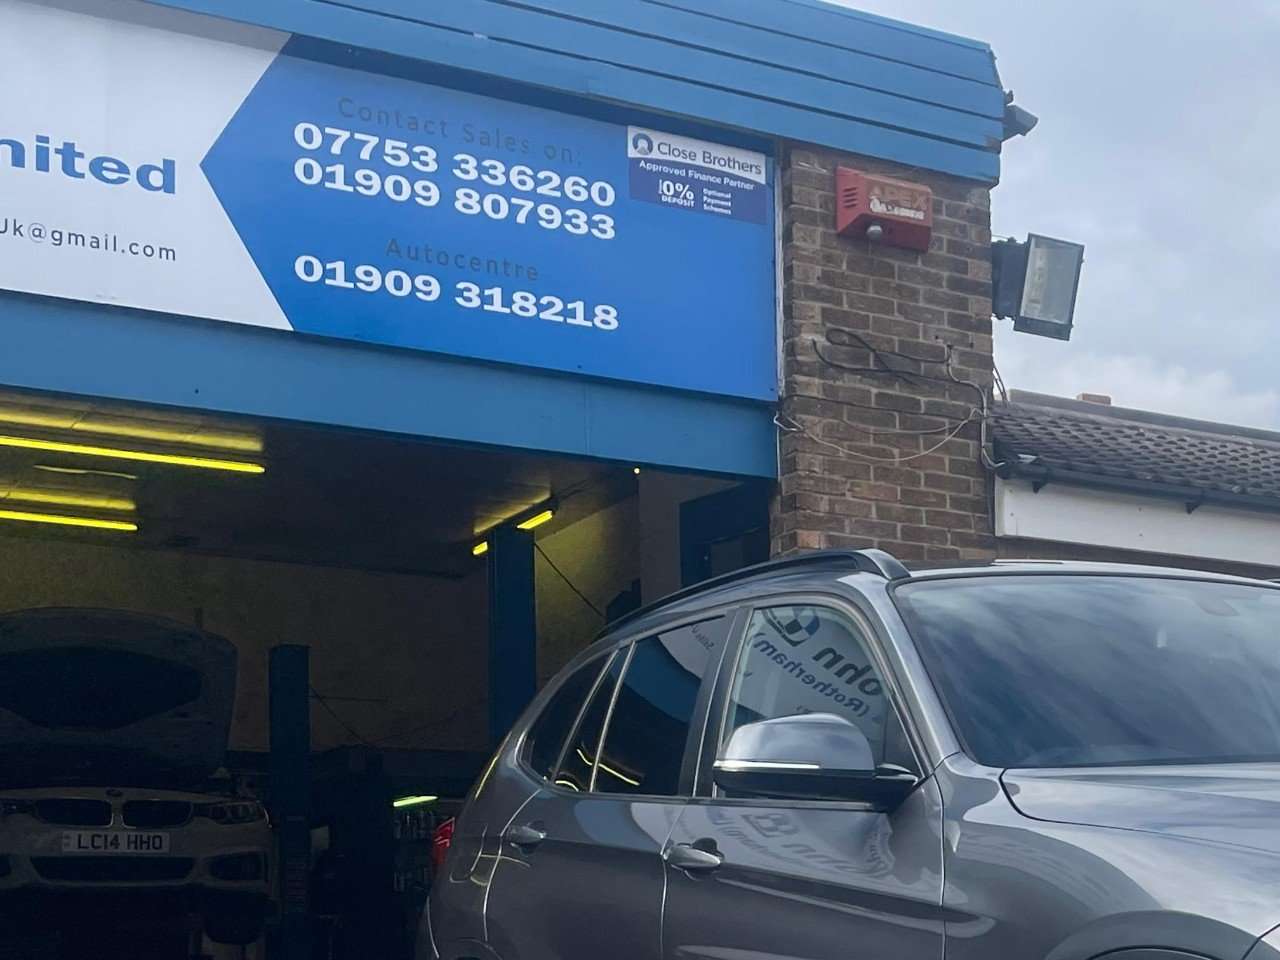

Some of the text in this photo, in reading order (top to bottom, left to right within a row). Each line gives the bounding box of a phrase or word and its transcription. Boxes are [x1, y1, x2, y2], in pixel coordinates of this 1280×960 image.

[337, 97, 448, 137] Contact
[463, 123, 530, 153] Sales
[293, 122, 616, 207] 07753 336260
[639, 160, 755, 190] Approved Finance Partner
[657, 142, 762, 175] Close Brothers
[293, 157, 616, 240] 01909 807933
[384, 238, 540, 282] Autocentre
[294, 255, 620, 331] 01909 318218
[77, 833, 121, 850] LC14
